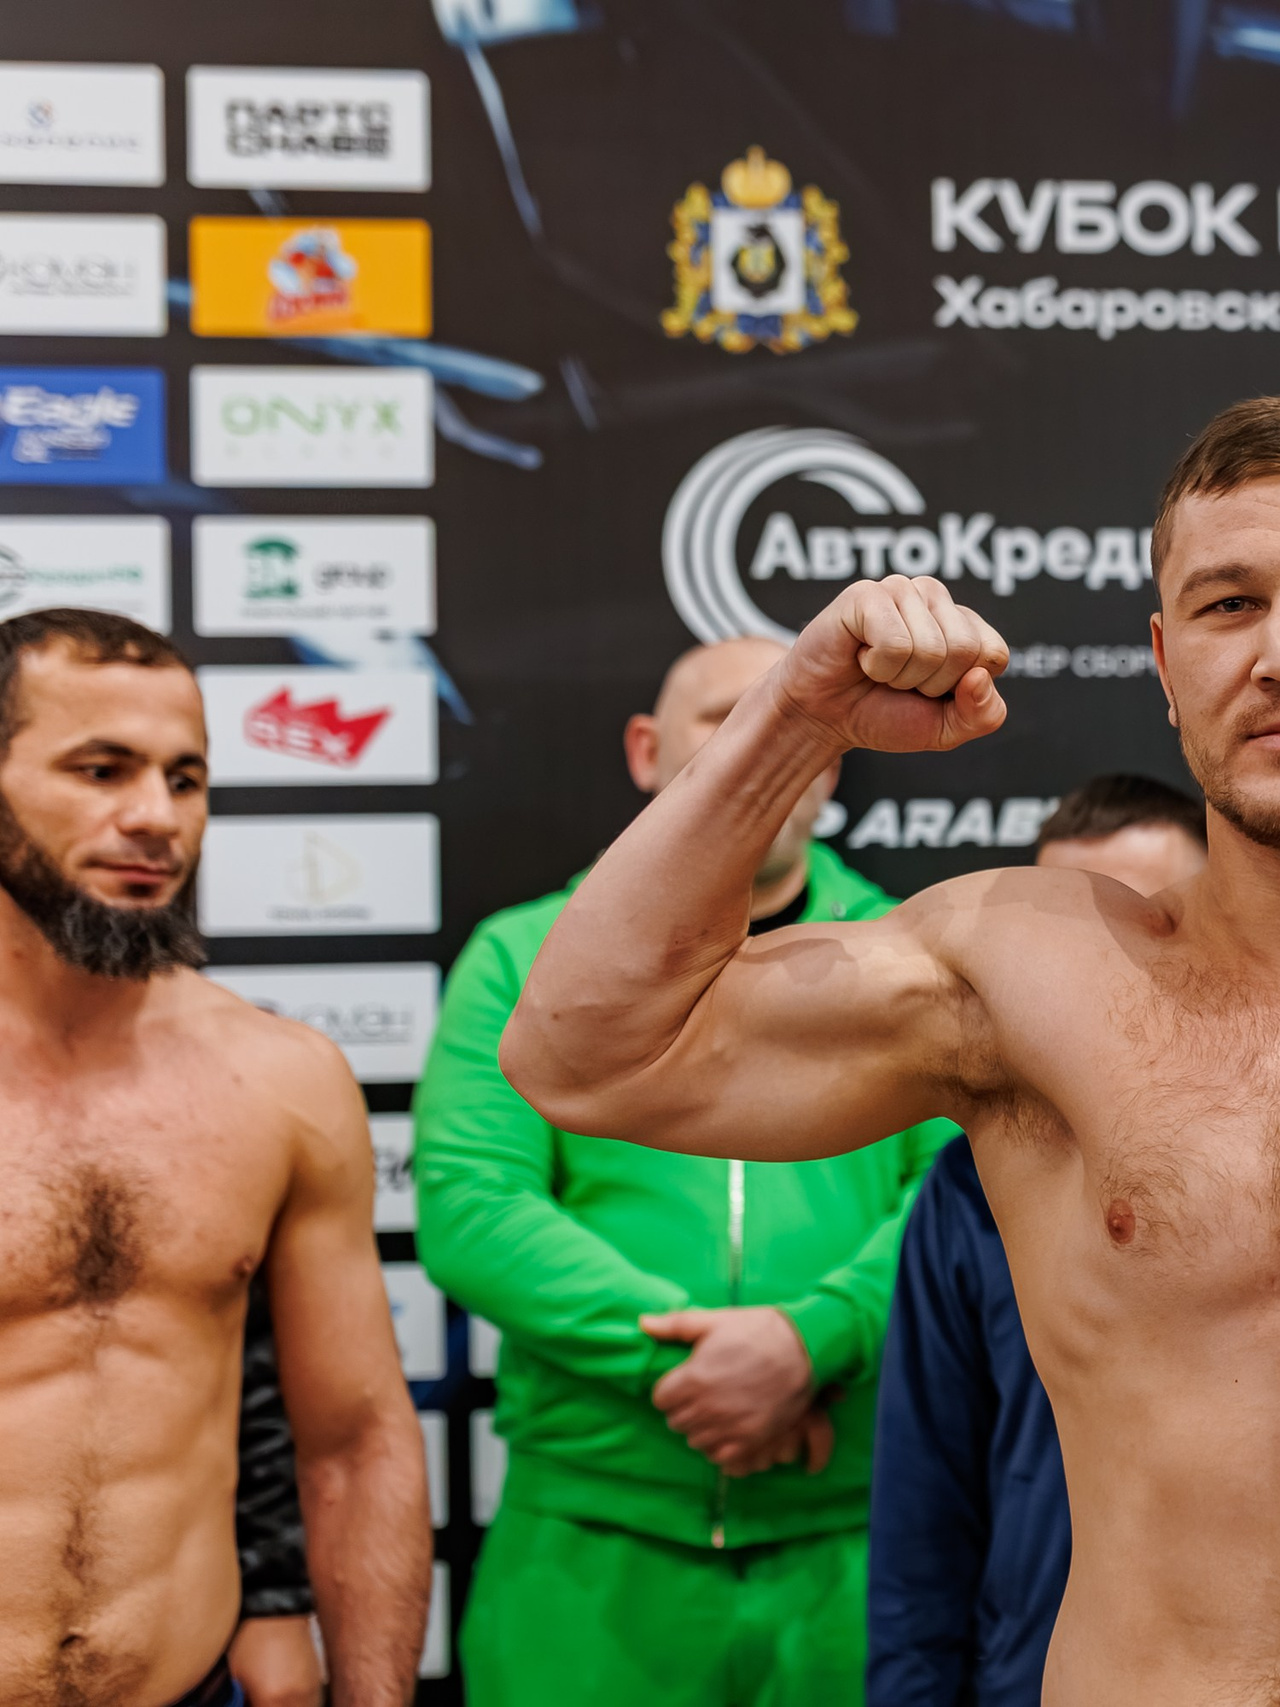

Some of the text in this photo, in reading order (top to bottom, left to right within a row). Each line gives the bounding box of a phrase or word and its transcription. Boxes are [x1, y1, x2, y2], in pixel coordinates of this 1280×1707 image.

[932, 176, 1261, 257] КУБОК
[221, 394, 401, 436] ONYX
[750, 511, 1152, 596] АвтоКред
[845, 796, 1062, 849] ARAB
